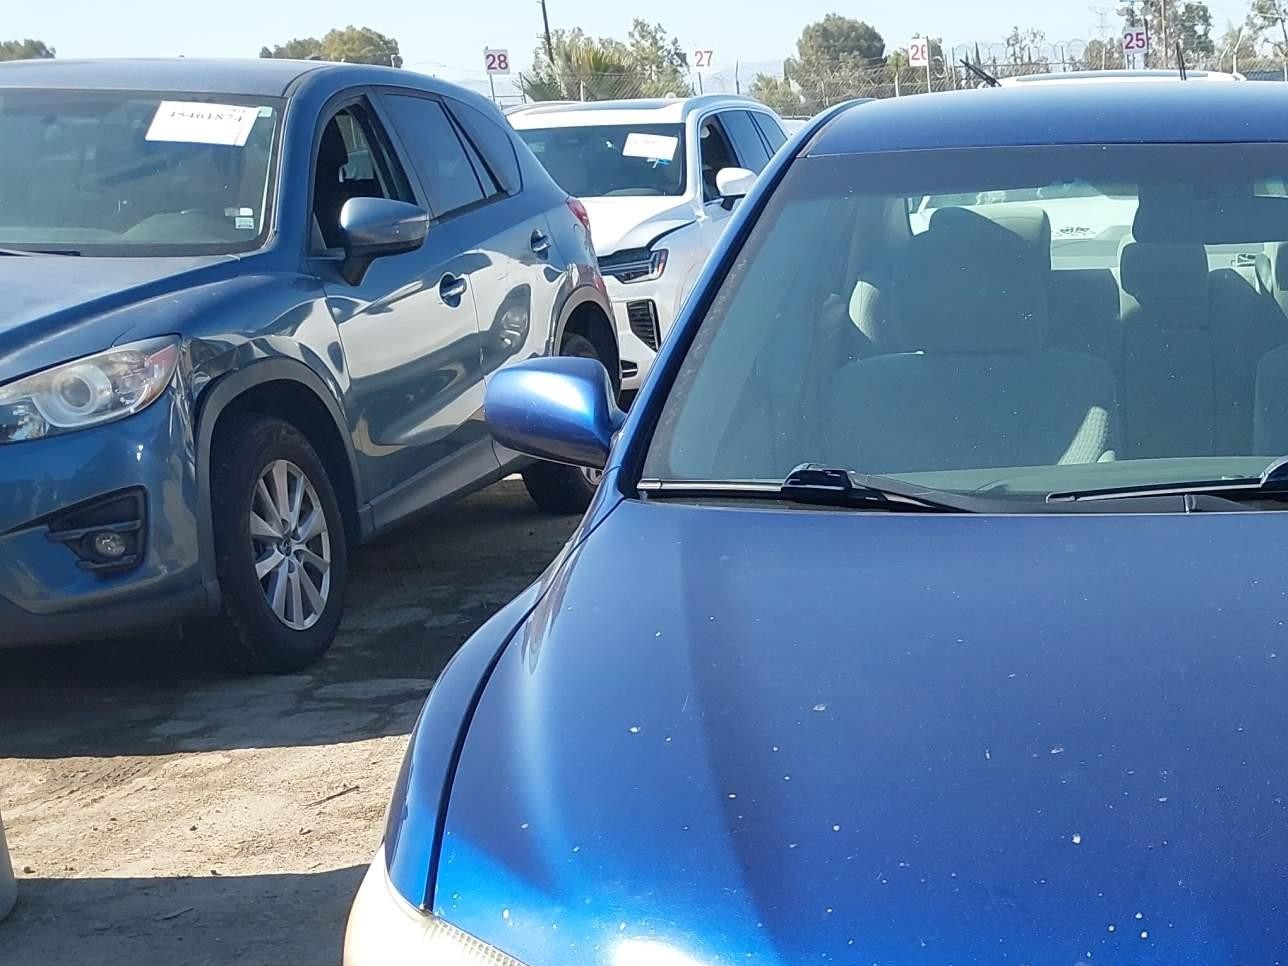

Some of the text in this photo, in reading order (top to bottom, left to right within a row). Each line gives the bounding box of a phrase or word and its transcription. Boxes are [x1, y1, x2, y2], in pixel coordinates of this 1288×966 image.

[1124, 32, 1145, 50] 25
[485, 54, 509, 70] 28
[694, 50, 714, 67] 27
